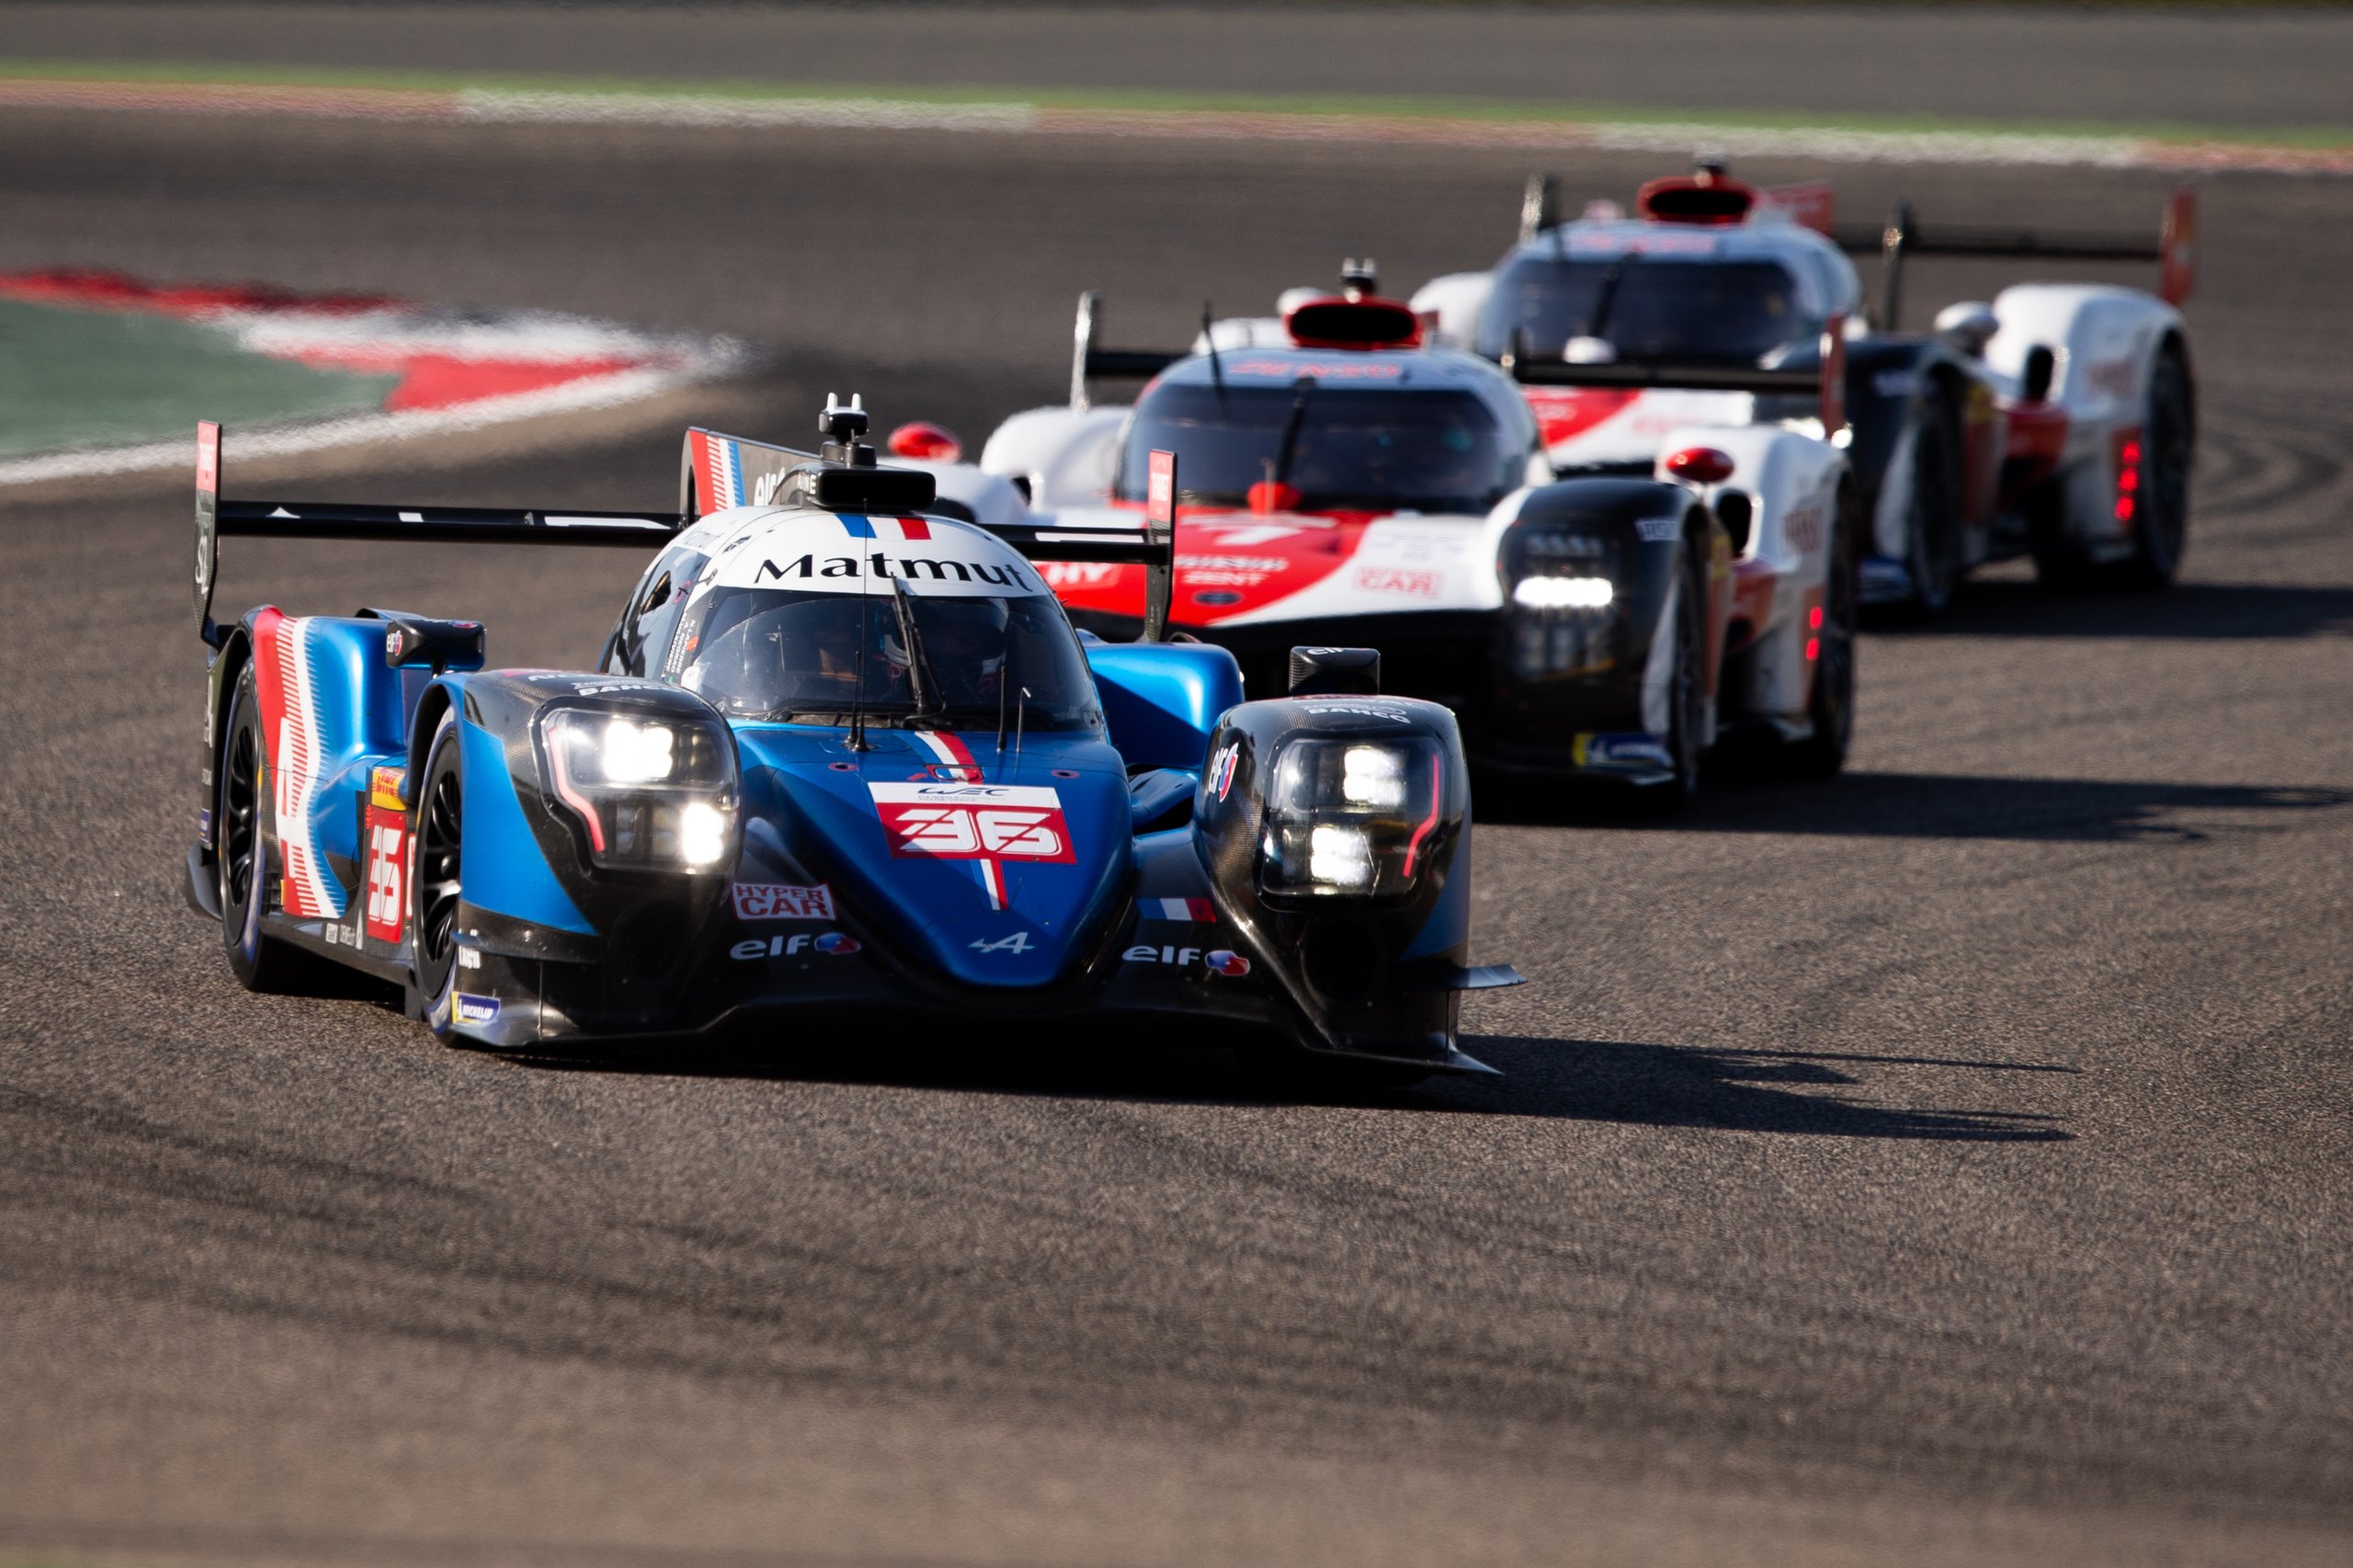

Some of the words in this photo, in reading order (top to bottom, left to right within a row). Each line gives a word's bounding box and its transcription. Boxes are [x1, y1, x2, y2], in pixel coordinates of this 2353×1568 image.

[754, 552, 1033, 593] Matmut
[1208, 746, 1229, 794] elf
[917, 787, 1010, 797] WEC
[895, 809, 1063, 856] 36
[735, 886, 824, 901] HYPER
[740, 897, 829, 916] CAR
[730, 934, 812, 960] elf
[1121, 946, 1201, 966] elf
